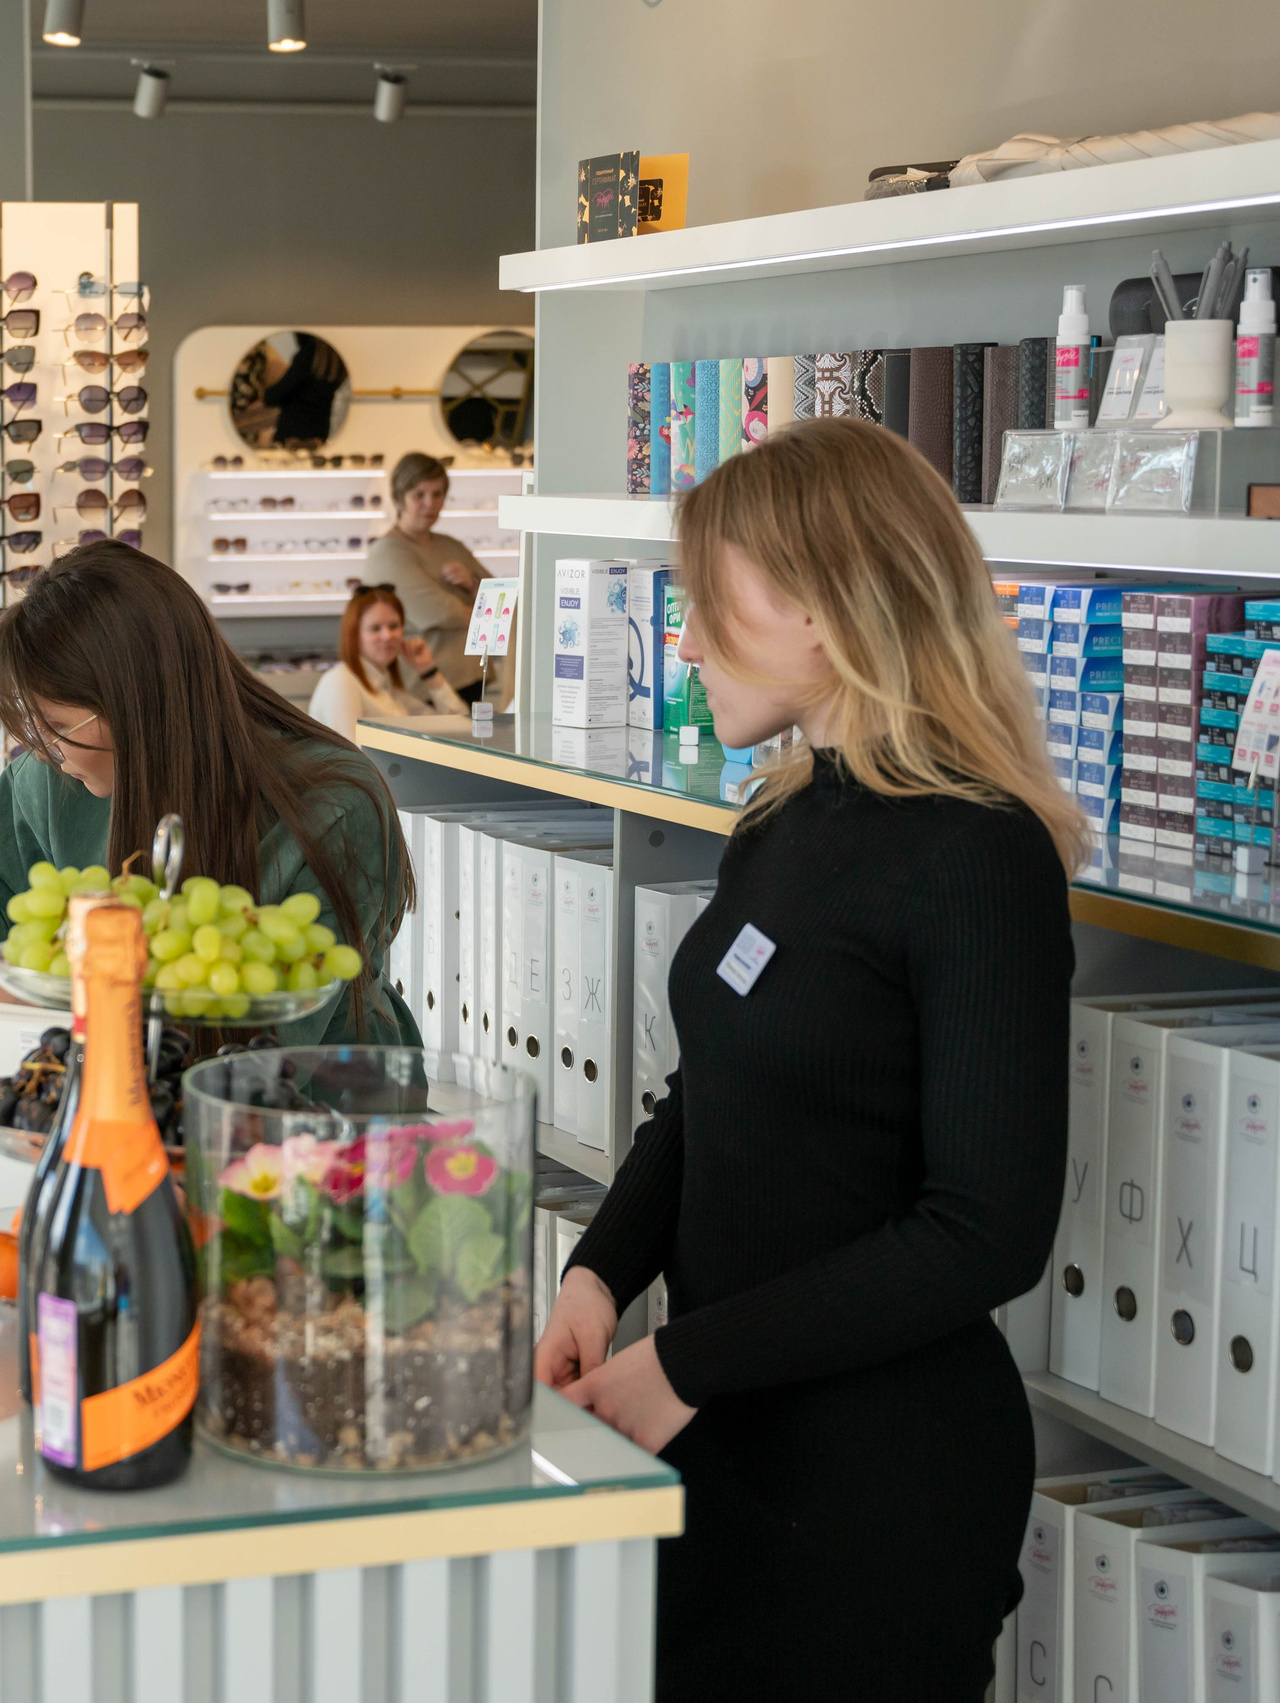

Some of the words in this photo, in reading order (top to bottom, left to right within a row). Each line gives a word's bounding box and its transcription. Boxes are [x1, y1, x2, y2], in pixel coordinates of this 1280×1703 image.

[557, 569, 586, 579] AVIZOR
[530, 959, 540, 993] Е
[584, 976, 602, 1014] Ж
[644, 1013, 657, 1051] К
[1120, 1179, 1145, 1225] Ф
[1238, 1222, 1258, 1283] Ц
